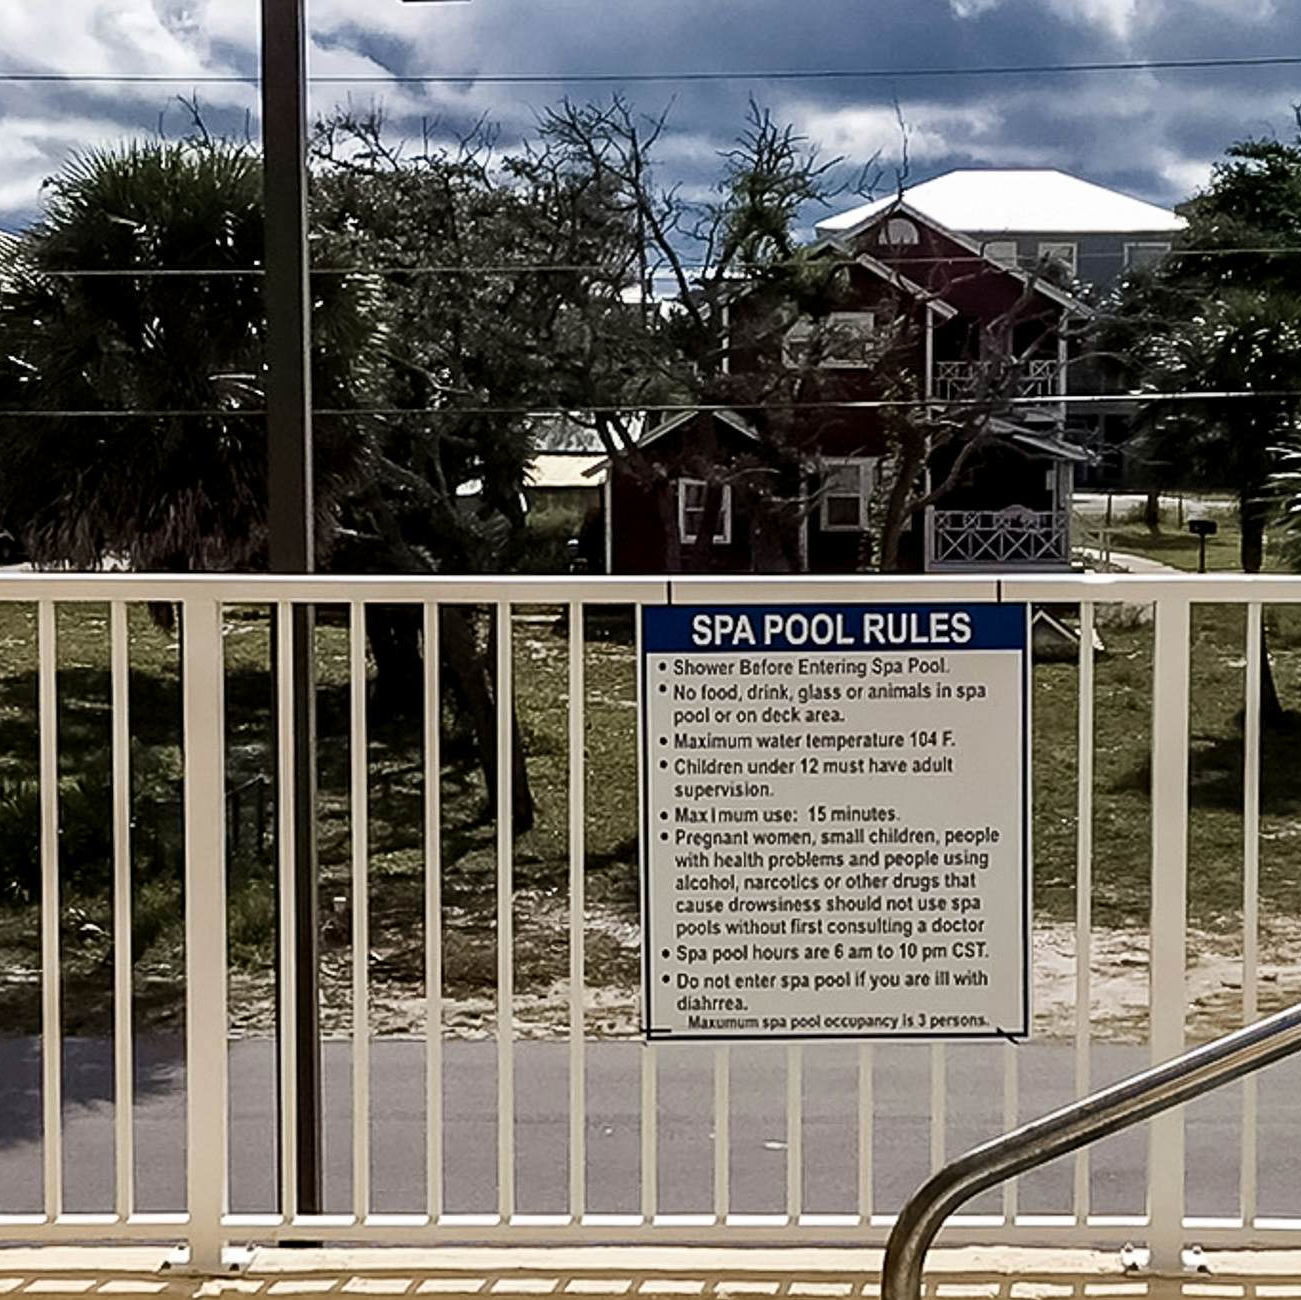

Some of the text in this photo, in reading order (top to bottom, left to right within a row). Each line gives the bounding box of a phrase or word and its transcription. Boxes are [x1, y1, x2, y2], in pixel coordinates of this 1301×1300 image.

[693, 613, 971, 645] SPA POOL RULES
[674, 657, 949, 679] Shower Before Entering Spa Pool.
[674, 682, 986, 704] No food, drink, glass or animals in spa
[674, 707, 845, 728] pool or on deck area.
[675, 730, 955, 752] Maximum water temperature 104 F.
[675, 756, 952, 776] Children under 12 must have adult
[675, 782, 773, 802] supervision.
[763, 810, 797, 823] use:
[809, 806, 826, 823] 15
[831, 806, 900, 823] minutes.
[676, 827, 999, 851] Pregnant women, small children, people
[675, 850, 988, 872] with health problems and people using
[676, 872, 975, 893] alcohol, narcotics or other drugs that
[676, 896, 980, 915] cause drowsiness should not use spa
[677, 917, 984, 939] pools without first consulting a doctor
[677, 942, 988, 965] Spa pool hours are 6 am to 10 pm CST.
[677, 970, 988, 992] Do not enter spa pool if you are ill with
[677, 996, 748, 1011] diahrrea.
[763, 1018, 786, 1031] spa
[791, 1015, 820, 1031] pool
[824, 1017, 898, 1030] occupancy
[903, 1014, 913, 1028] is
[919, 1014, 926, 1028] 3
[930, 1016, 989, 1030] persons.
